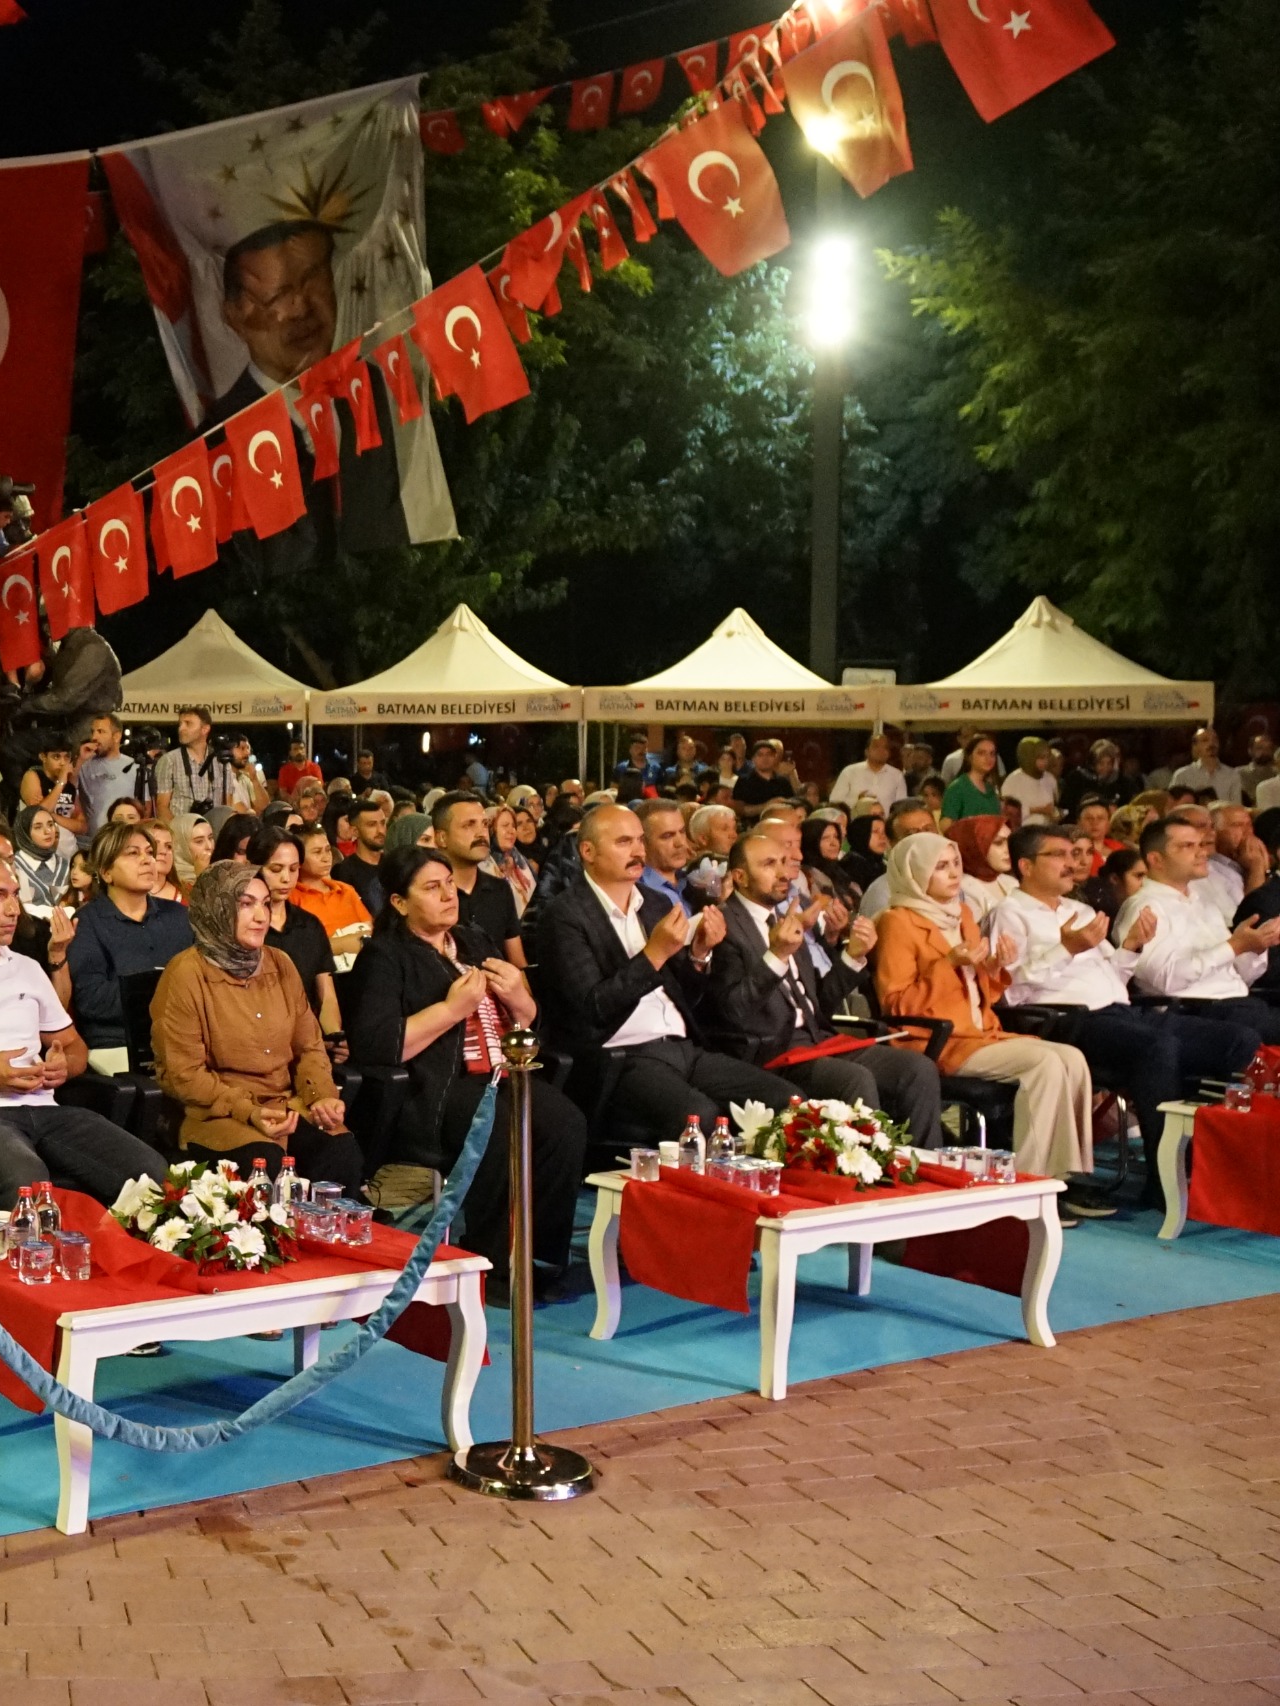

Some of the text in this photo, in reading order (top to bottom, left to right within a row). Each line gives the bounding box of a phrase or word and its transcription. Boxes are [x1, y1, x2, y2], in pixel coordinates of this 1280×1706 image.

[114, 702, 169, 713] BATMAN
[377, 703, 436, 715] BATMAN
[441, 699, 516, 715] BELEDİYESİ
[655, 698, 805, 713] BATMAN BELEDİYESİ
[962, 698, 1032, 711] BATMAN
[1038, 695, 1130, 711] BELEDİYESİ
